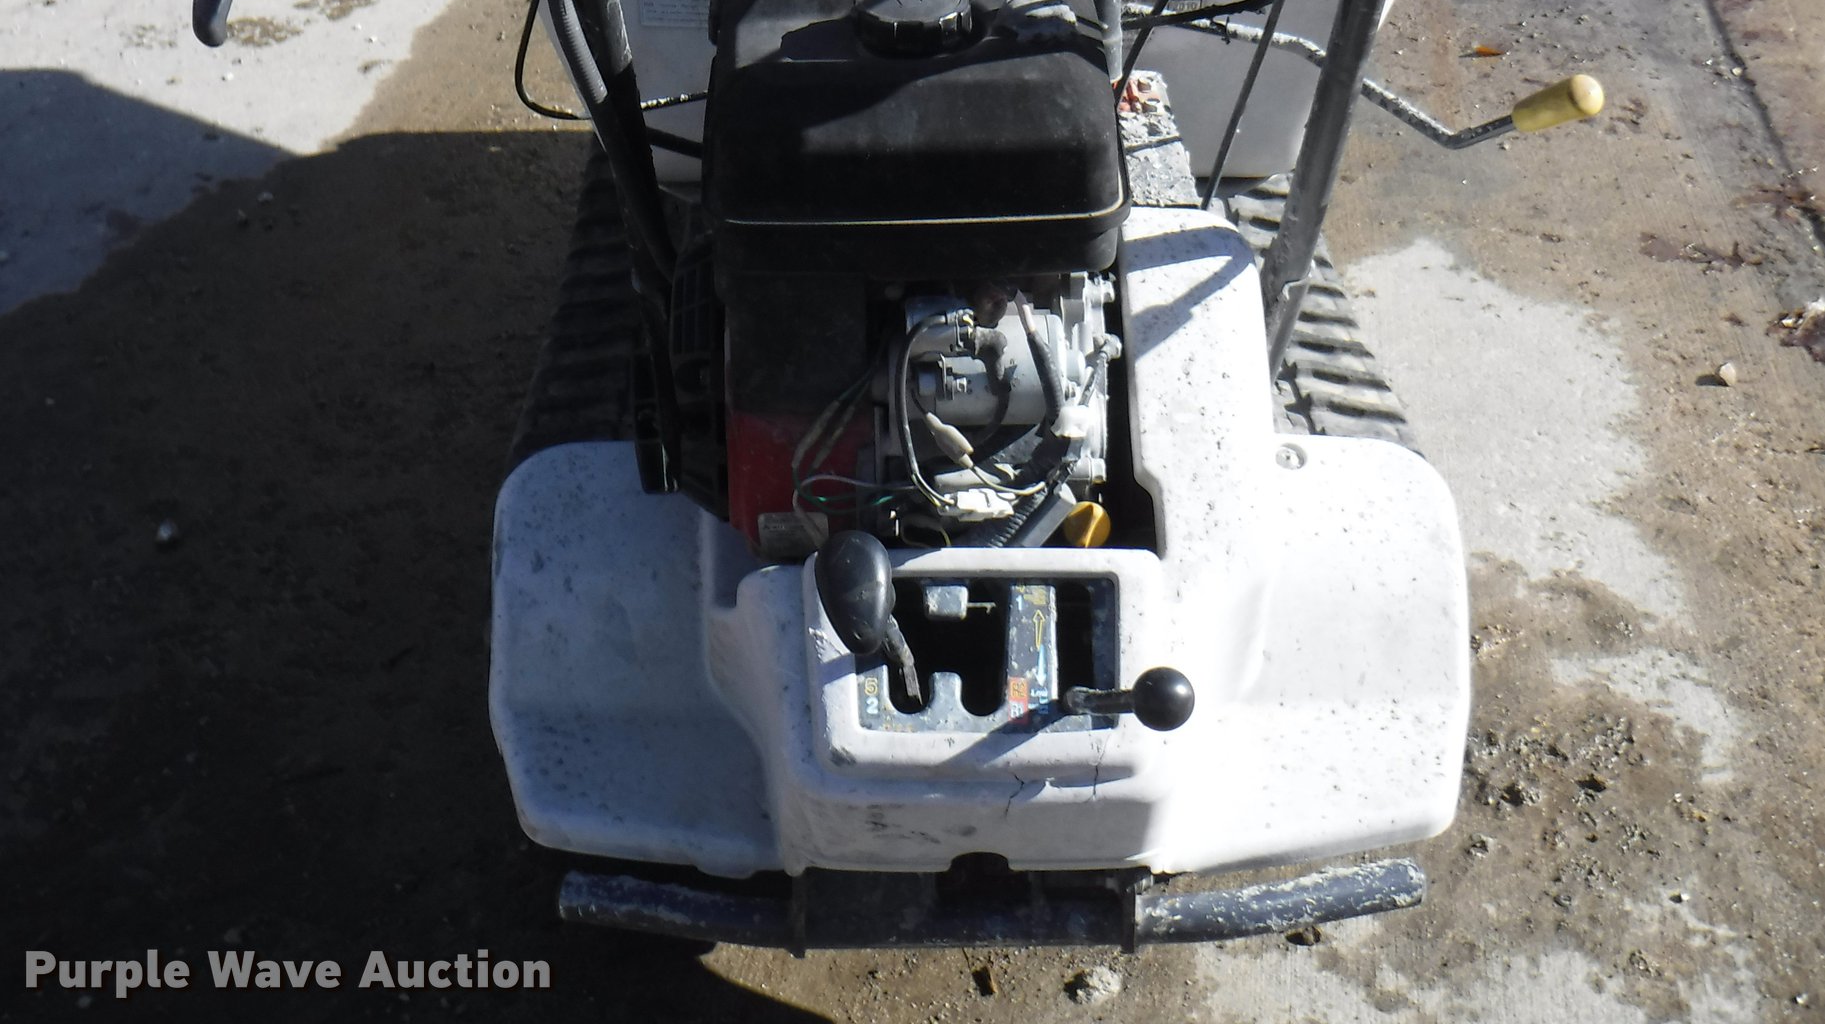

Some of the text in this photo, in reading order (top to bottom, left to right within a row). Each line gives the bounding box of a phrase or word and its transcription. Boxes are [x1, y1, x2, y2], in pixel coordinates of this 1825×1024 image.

[1015, 595, 1023, 611] 1
[864, 677, 878, 696] 5
[866, 697, 879, 714] 2
